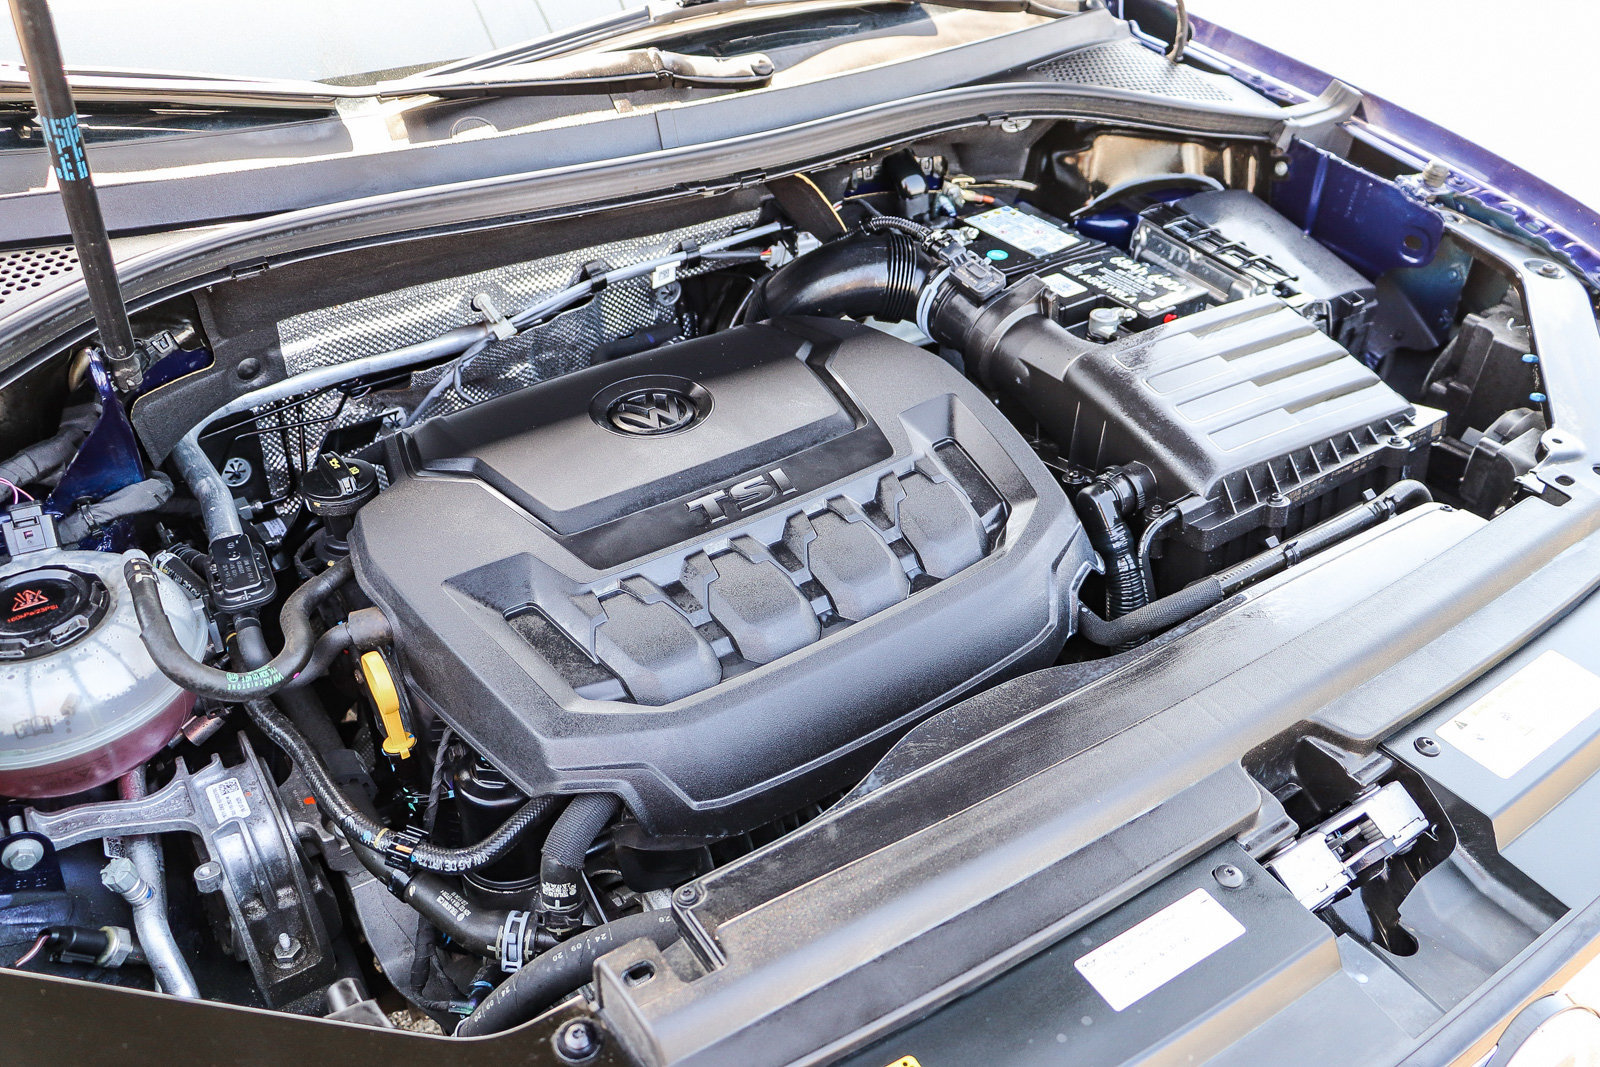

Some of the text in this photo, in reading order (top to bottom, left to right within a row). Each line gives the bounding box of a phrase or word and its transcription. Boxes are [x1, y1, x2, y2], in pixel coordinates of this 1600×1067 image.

[684, 467, 799, 525] TSI
[263, 676, 273, 687] AG
[272, 672, 284, 684] VW
[444, 860, 457, 872] DE
[457, 858, 472, 870] AG
[552, 932, 607, 962] 24 09 20
[473, 985, 511, 1022] 24 09 20
